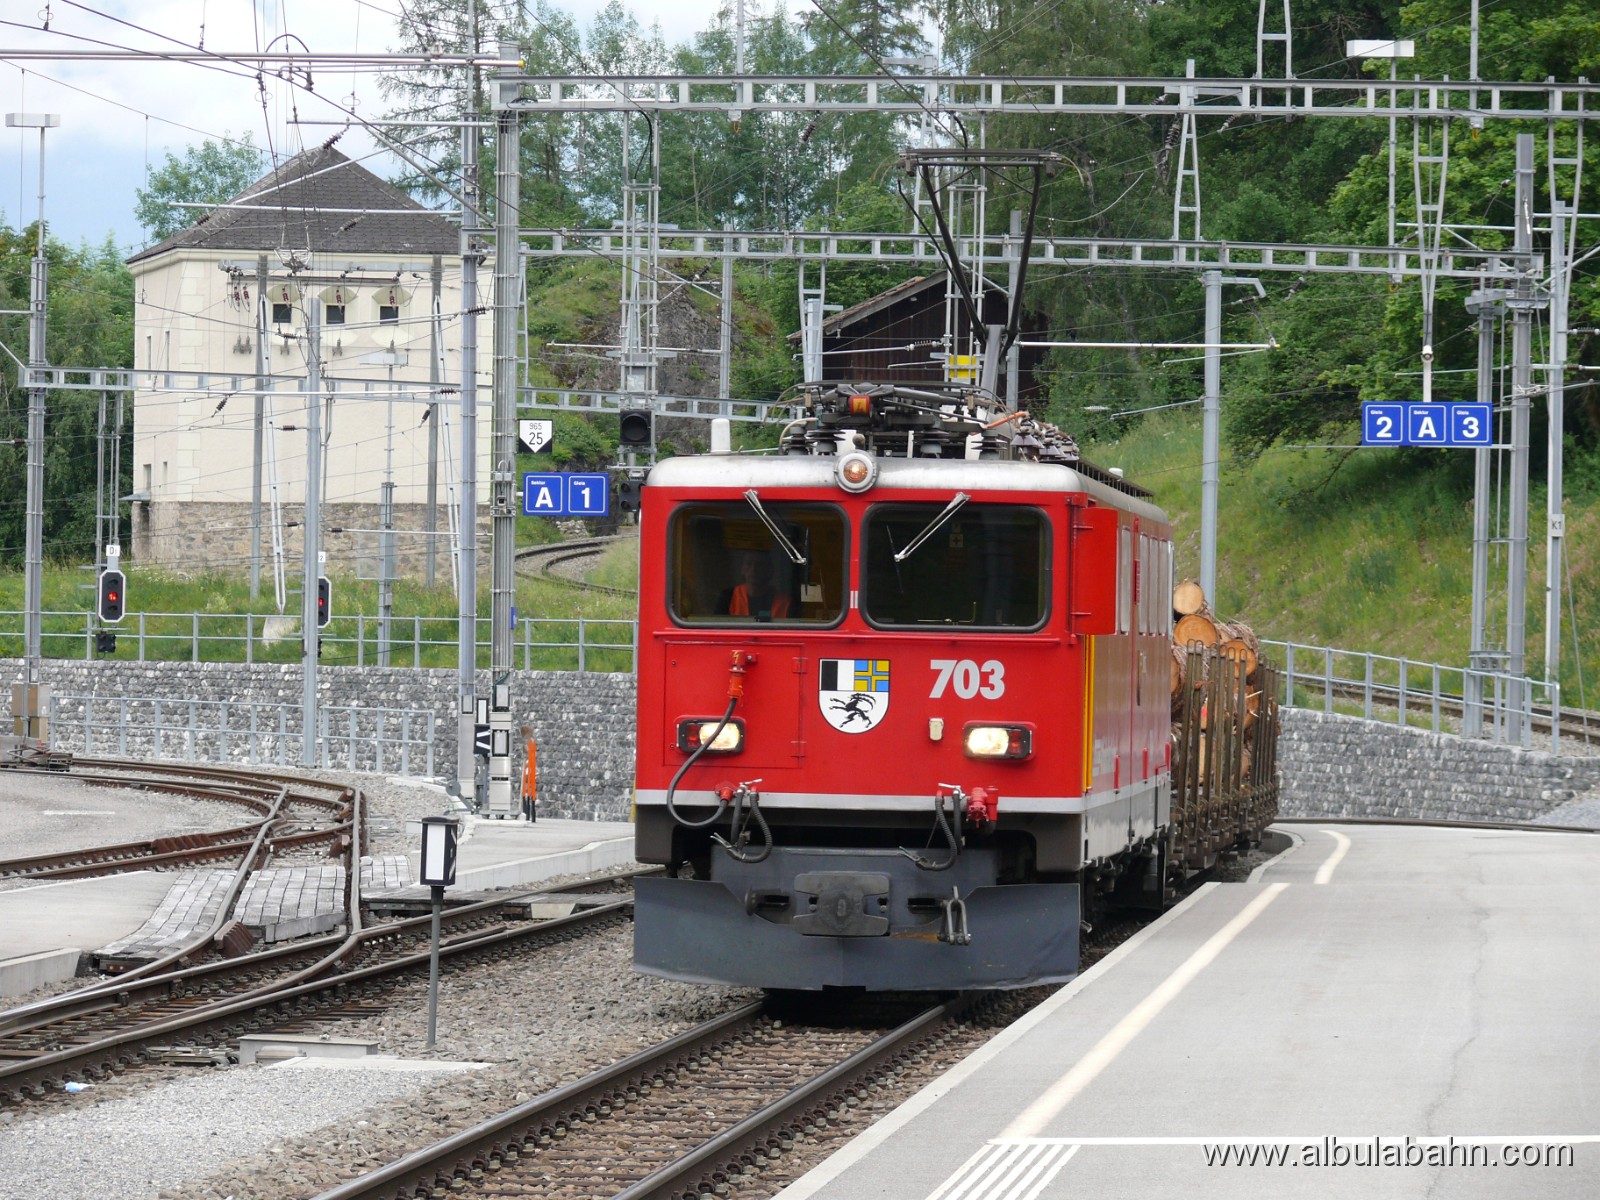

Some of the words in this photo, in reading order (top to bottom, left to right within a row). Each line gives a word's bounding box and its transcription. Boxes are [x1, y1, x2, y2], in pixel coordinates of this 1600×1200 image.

[529, 422, 542, 430] 965
[1376, 416, 1393, 438] 2
[1417, 416, 1437, 438] A
[1462, 416, 1479, 439] 3
[529, 432, 543, 445] 25
[535, 487, 553, 508] A
[581, 487, 590, 509] 1
[928, 658, 1006, 700] 703
